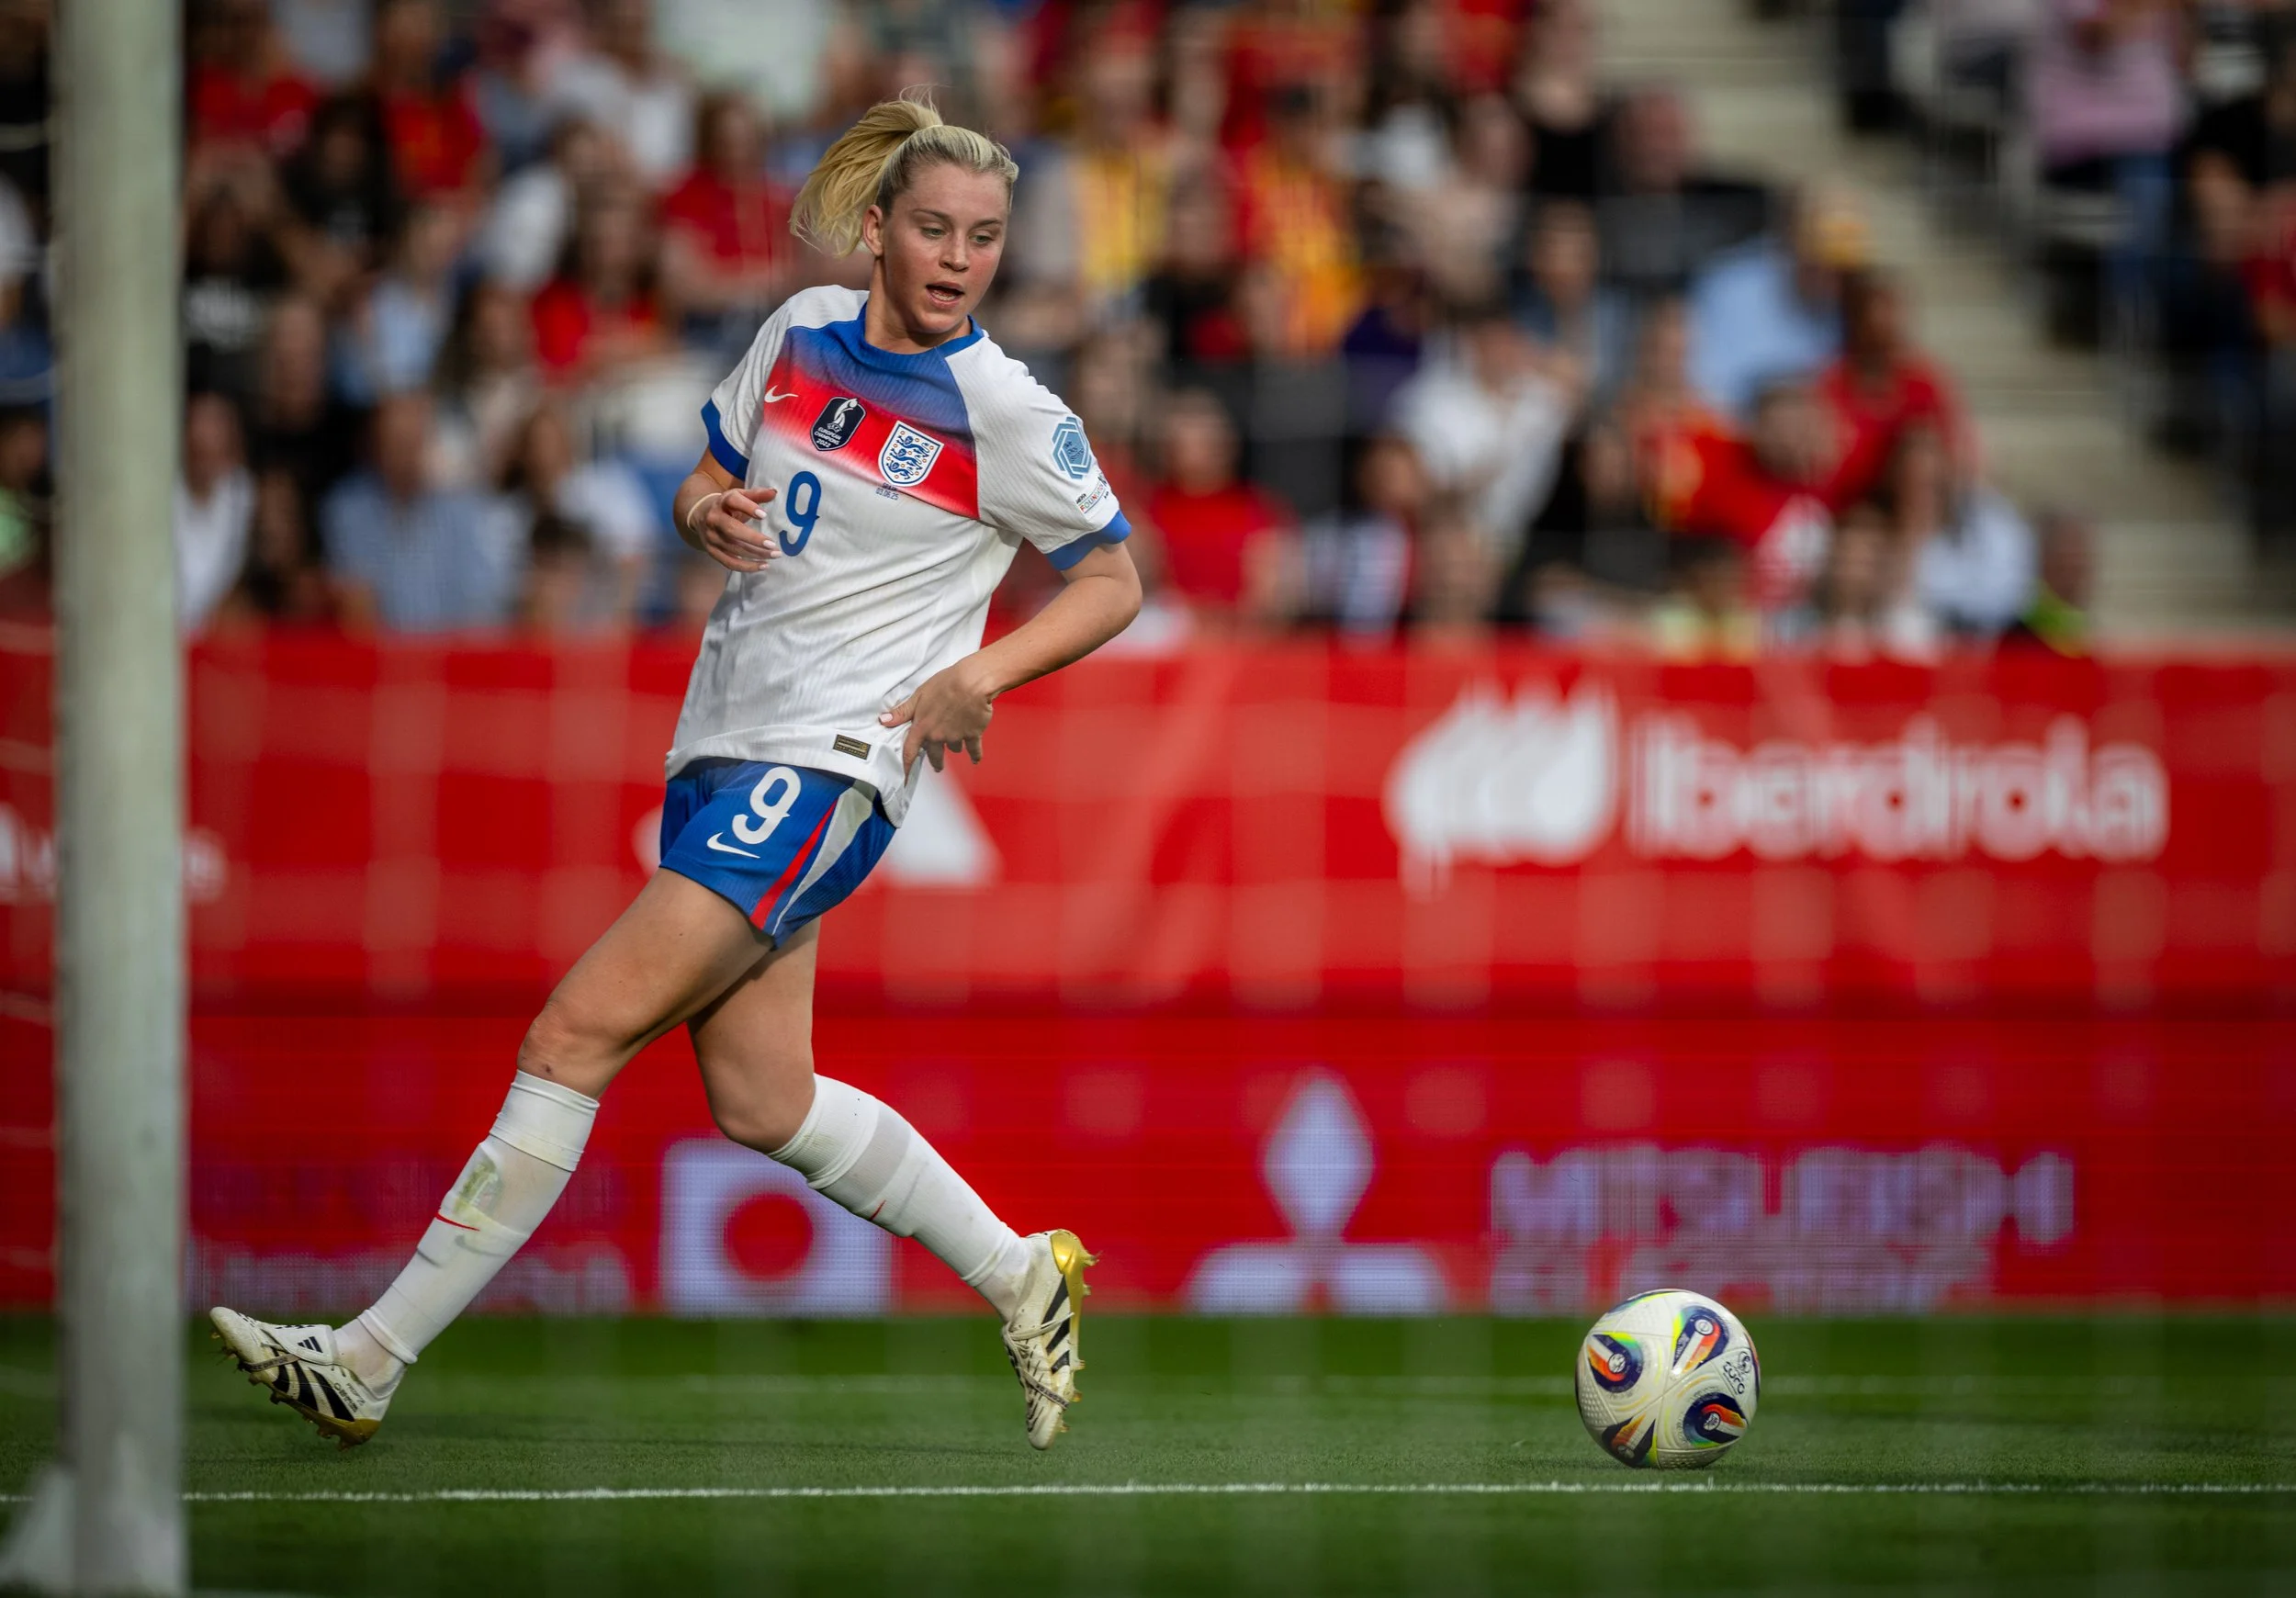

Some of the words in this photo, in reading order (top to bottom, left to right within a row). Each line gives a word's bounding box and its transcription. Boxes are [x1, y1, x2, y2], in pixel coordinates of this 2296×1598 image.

[814, 431, 840, 445] CHAMPIONS
[816, 438, 832, 448] 2022
[778, 470, 822, 557] 9
[732, 766, 802, 844] 9
